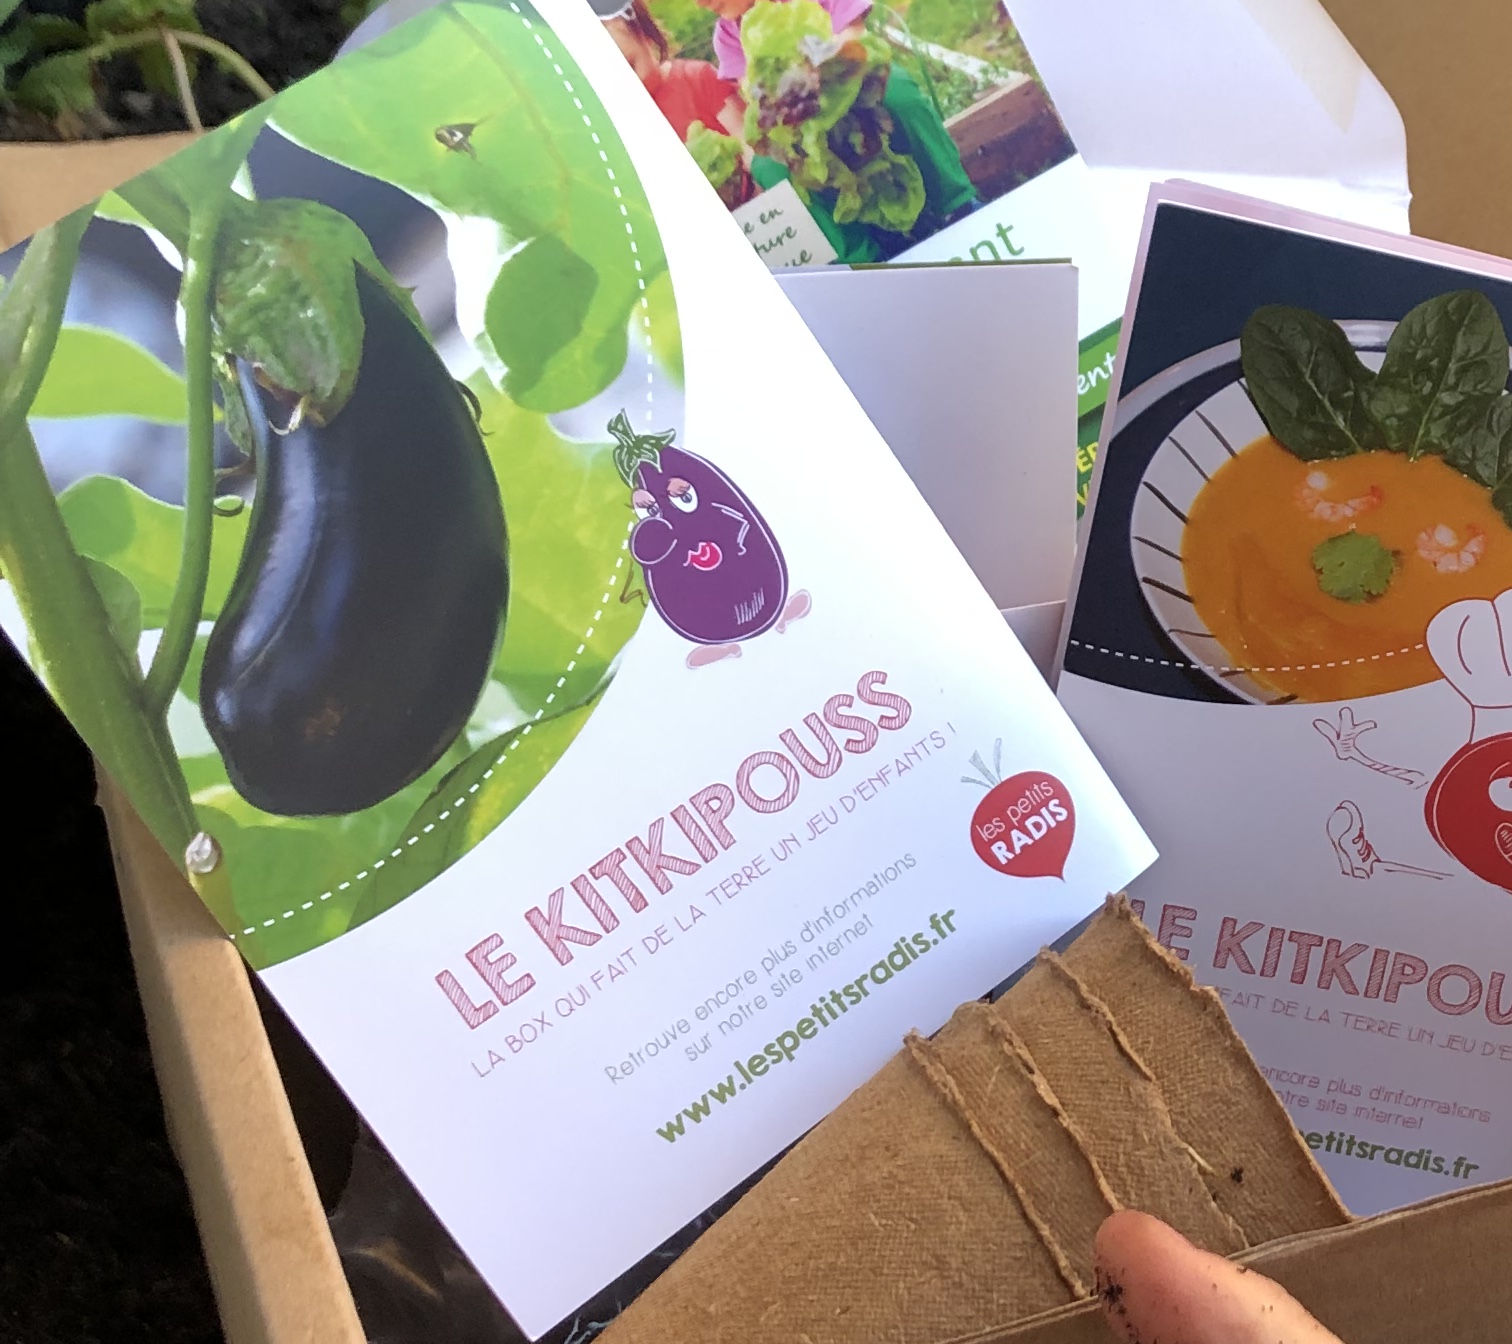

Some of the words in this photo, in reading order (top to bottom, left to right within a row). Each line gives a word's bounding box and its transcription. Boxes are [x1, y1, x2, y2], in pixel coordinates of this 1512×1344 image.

[759, 208, 784, 225] en
[941, 222, 1025, 263] nt
[975, 817, 1006, 842] les
[1006, 781, 1054, 826] petits
[990, 798, 1068, 865] RADIS
[435, 933, 536, 1030] LE
[524, 670, 912, 967] KITKIPOUSS
[471, 1049, 505, 1078] LA
[504, 1011, 553, 1054] BOX
[554, 984, 591, 1017] QUI
[590, 947, 640, 991] FAIT
[641, 924, 674, 955] DE
[674, 904, 706, 932] LA
[705, 855, 771, 906] TERRE
[770, 832, 802, 862] UN
[806, 806, 839, 841] JEU
[839, 730, 947, 814] D'ENFANTS
[604, 1017, 691, 1085] Retrouve
[695, 968, 758, 1022] encore
[761, 937, 798, 978] plus
[799, 852, 917, 944] d'informations
[684, 1031, 713, 1063] sur
[719, 990, 768, 1036] notre
[770, 966, 803, 998] site
[806, 912, 875, 972] internet
[656, 908, 958, 1144] www.lespetitsradis.fr
[1219, 987, 1265, 1010] FAIT
[1271, 997, 1299, 1018] DE
[1304, 1005, 1331, 1024] LA
[1339, 1010, 1402, 1039] TERRE
[1407, 1024, 1436, 1046] UN
[1437, 1033, 1476, 1054] JEU
[1316, 1098, 1347, 1115] site
[1355, 1106, 1425, 1130] internet
[1327, 1077, 1362, 1098] plus
[1368, 1084, 1492, 1124] d'informations
[1299, 1127, 1480, 1179] etitsradis.fr
